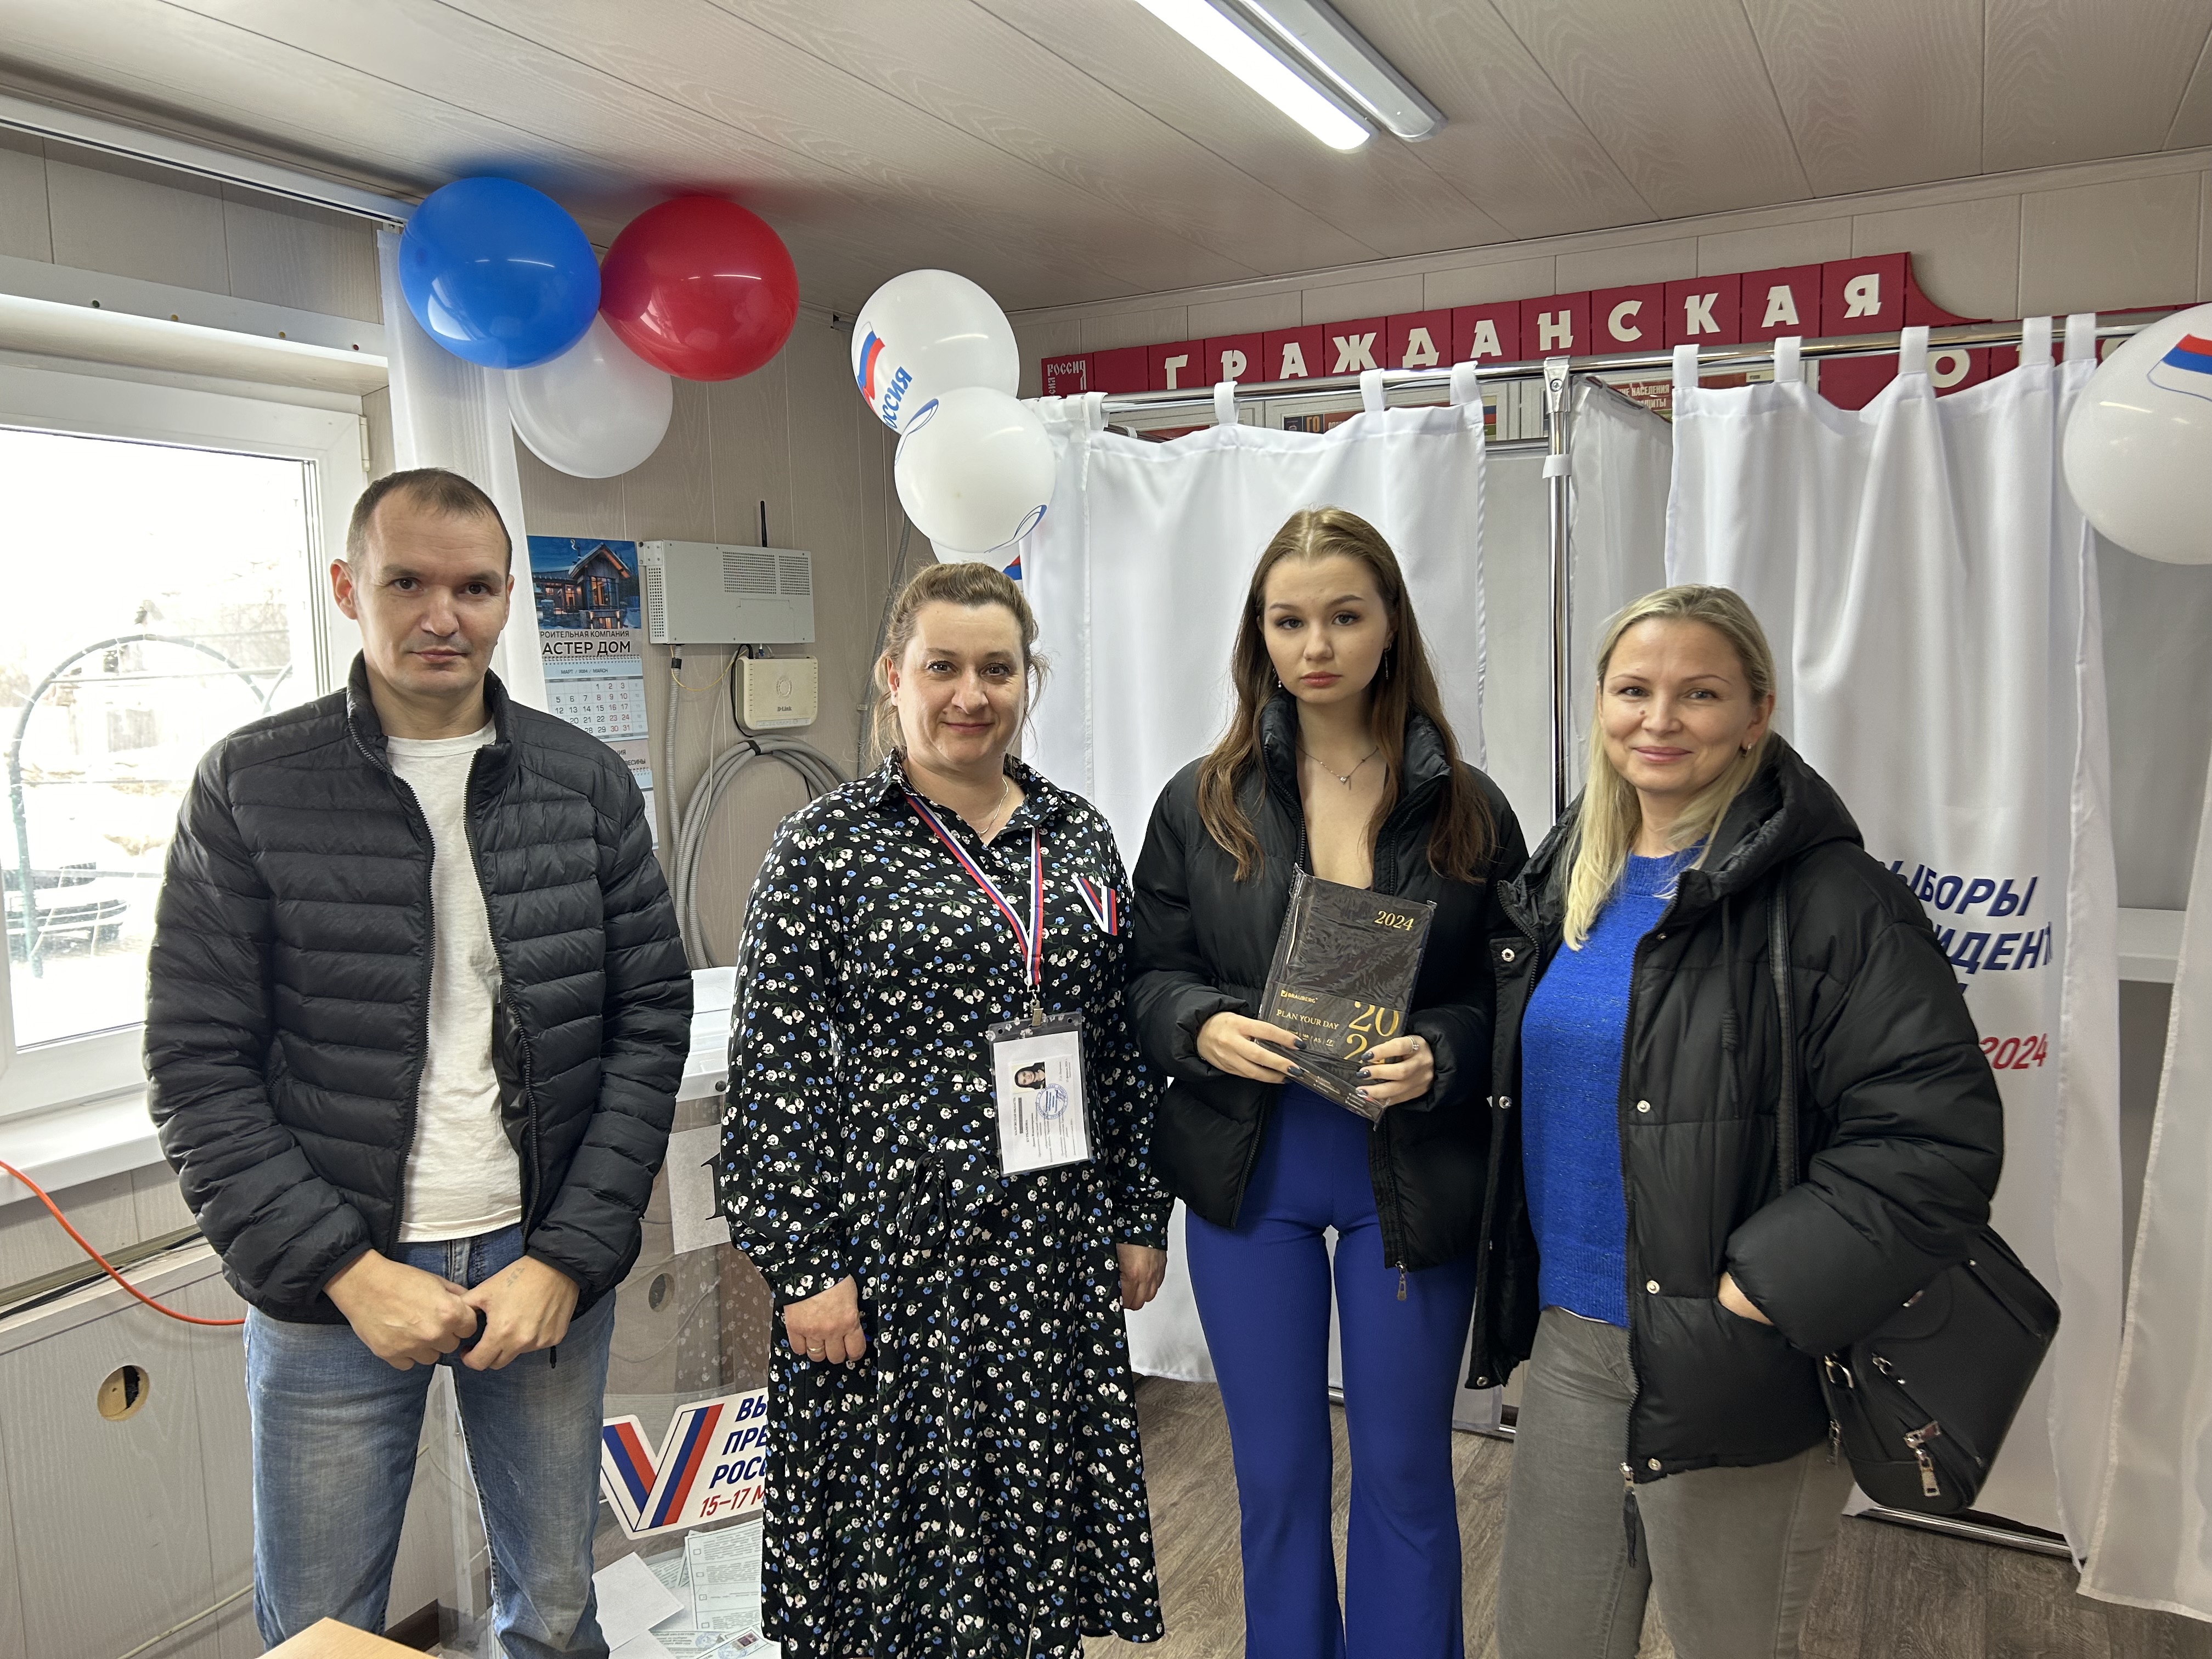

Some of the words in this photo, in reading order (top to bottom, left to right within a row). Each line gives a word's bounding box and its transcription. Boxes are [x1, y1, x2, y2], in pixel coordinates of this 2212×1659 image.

[1164, 273, 1882, 390] ГРАЖДАНСКАЯ
[1047, 360, 1087, 390] РОССИЯ
[882, 366, 913, 431] ОССИЯ
[1632, 385, 1670, 396] НАСЕЛЕНИЯ
[543, 641, 593, 655] АСТЕР
[597, 641, 630, 657] ДОМ
[1374, 910, 1415, 931] 2024
[1277, 1008, 1299, 1021] PLAN
[1299, 1014, 1322, 1026] YOUR
[1322, 1020, 1340, 1030] DAY
[721, 1425, 767, 1456] ПРЕ
